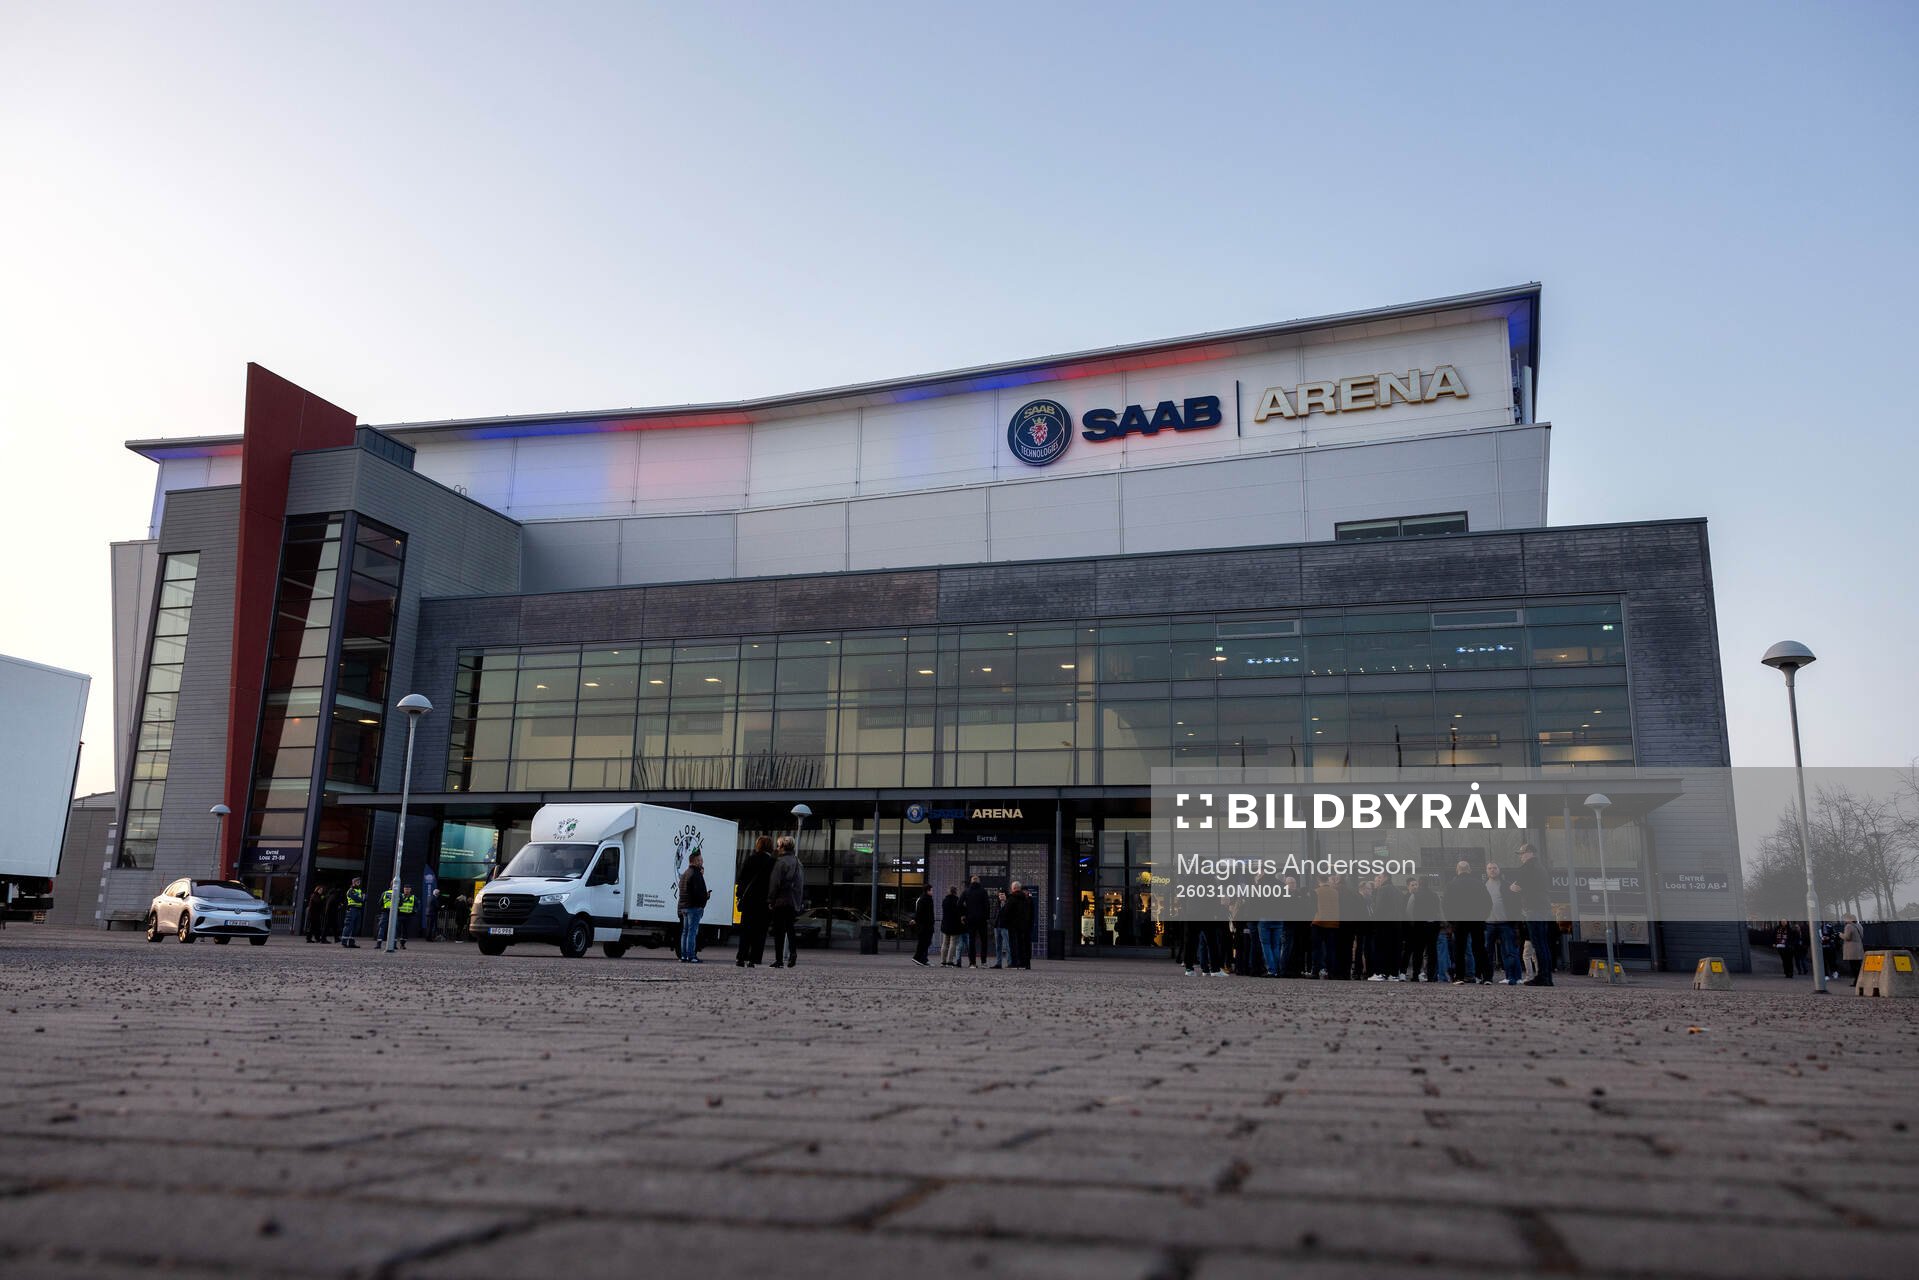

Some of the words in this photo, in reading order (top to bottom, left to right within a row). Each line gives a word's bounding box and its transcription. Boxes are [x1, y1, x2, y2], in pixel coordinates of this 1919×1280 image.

[1082, 395, 1222, 442] SAAB
[1254, 364, 1469, 422] ARENA
[1024, 405, 1055, 419] SAAB
[1020, 441, 1058, 458] TECHNOLOGIES
[972, 808, 1023, 818] ARENA
[673, 824, 704, 849] GLOBAL
[1552, 876, 1640, 888] KUDER
